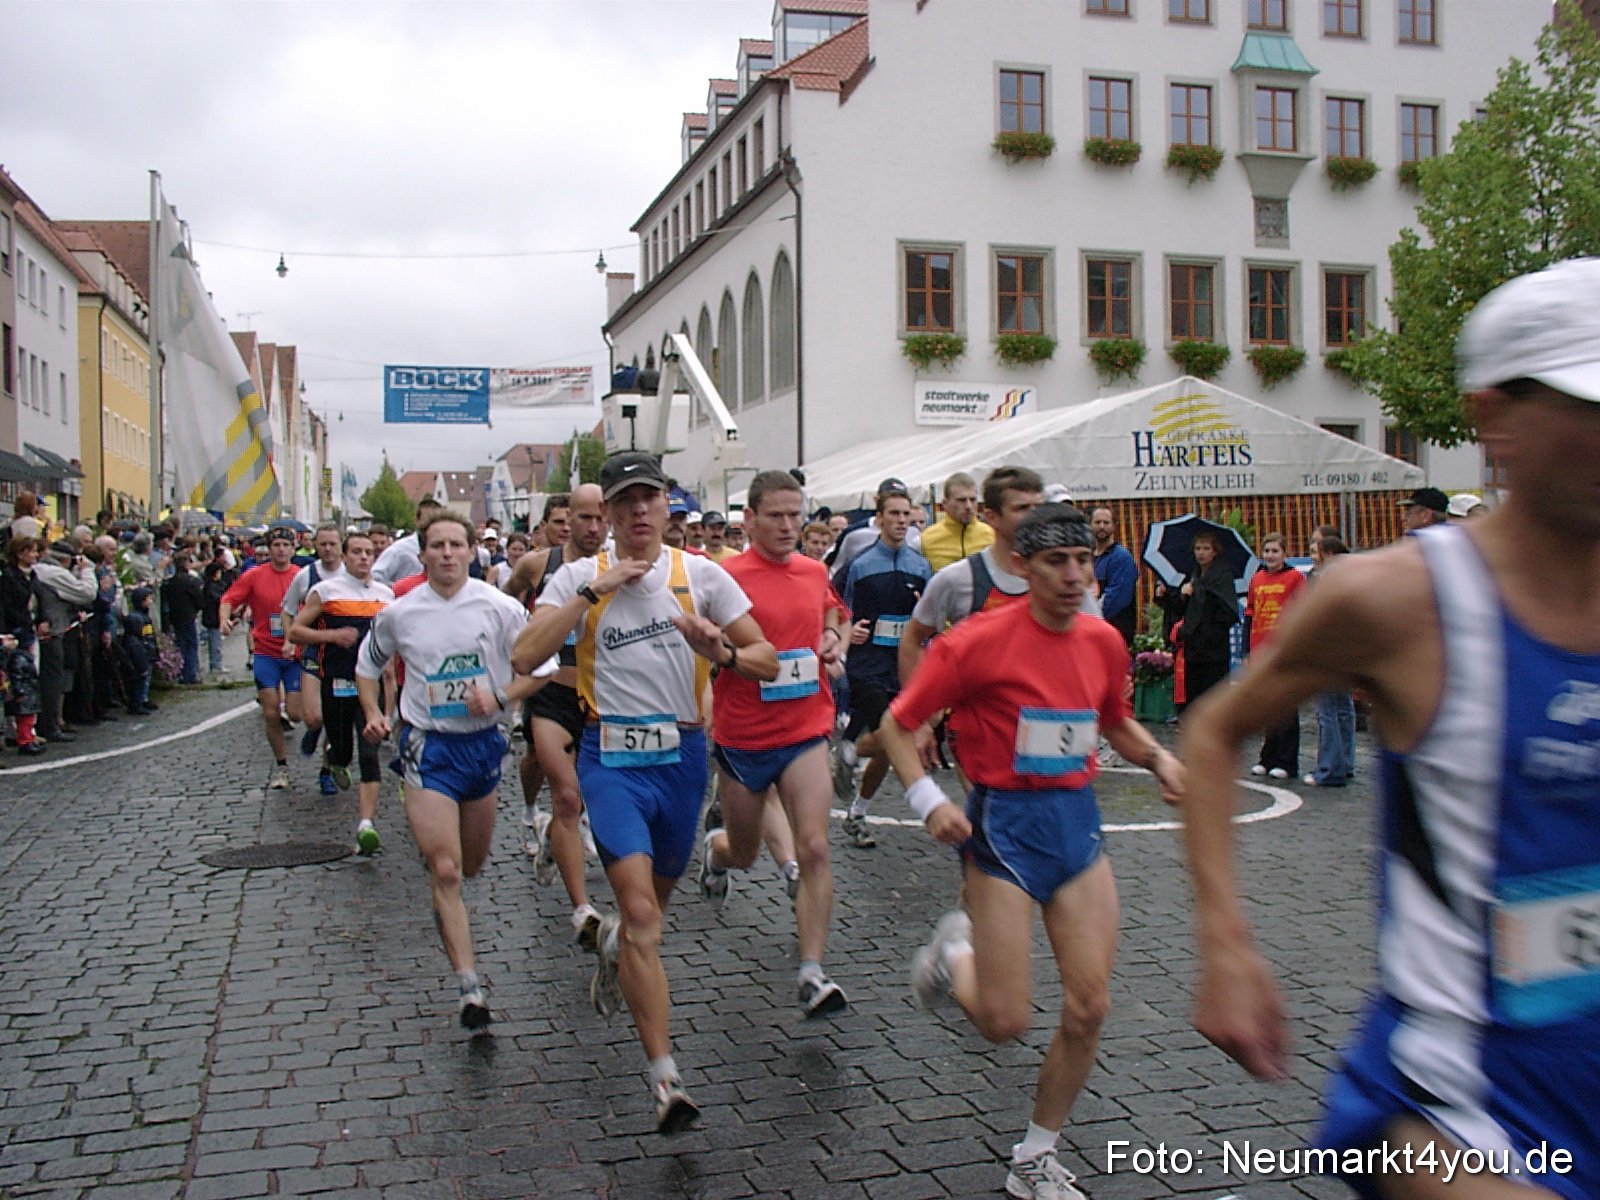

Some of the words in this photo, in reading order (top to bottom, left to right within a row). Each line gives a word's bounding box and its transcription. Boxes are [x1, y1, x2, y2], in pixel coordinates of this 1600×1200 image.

[390, 368, 482, 390] BOCK
[924, 390, 990, 402] stadtwerke
[921, 403, 977, 413] neumarkt
[1131, 431, 1252, 467] HÄRTEIS
[1135, 471, 1255, 490] ZELTVERLEIH
[1327, 472, 1360, 486] 09180
[1370, 470, 1388, 484] 402
[791, 660, 800, 681] 4
[444, 677, 477, 702] 22
[625, 727, 662, 750] 571
